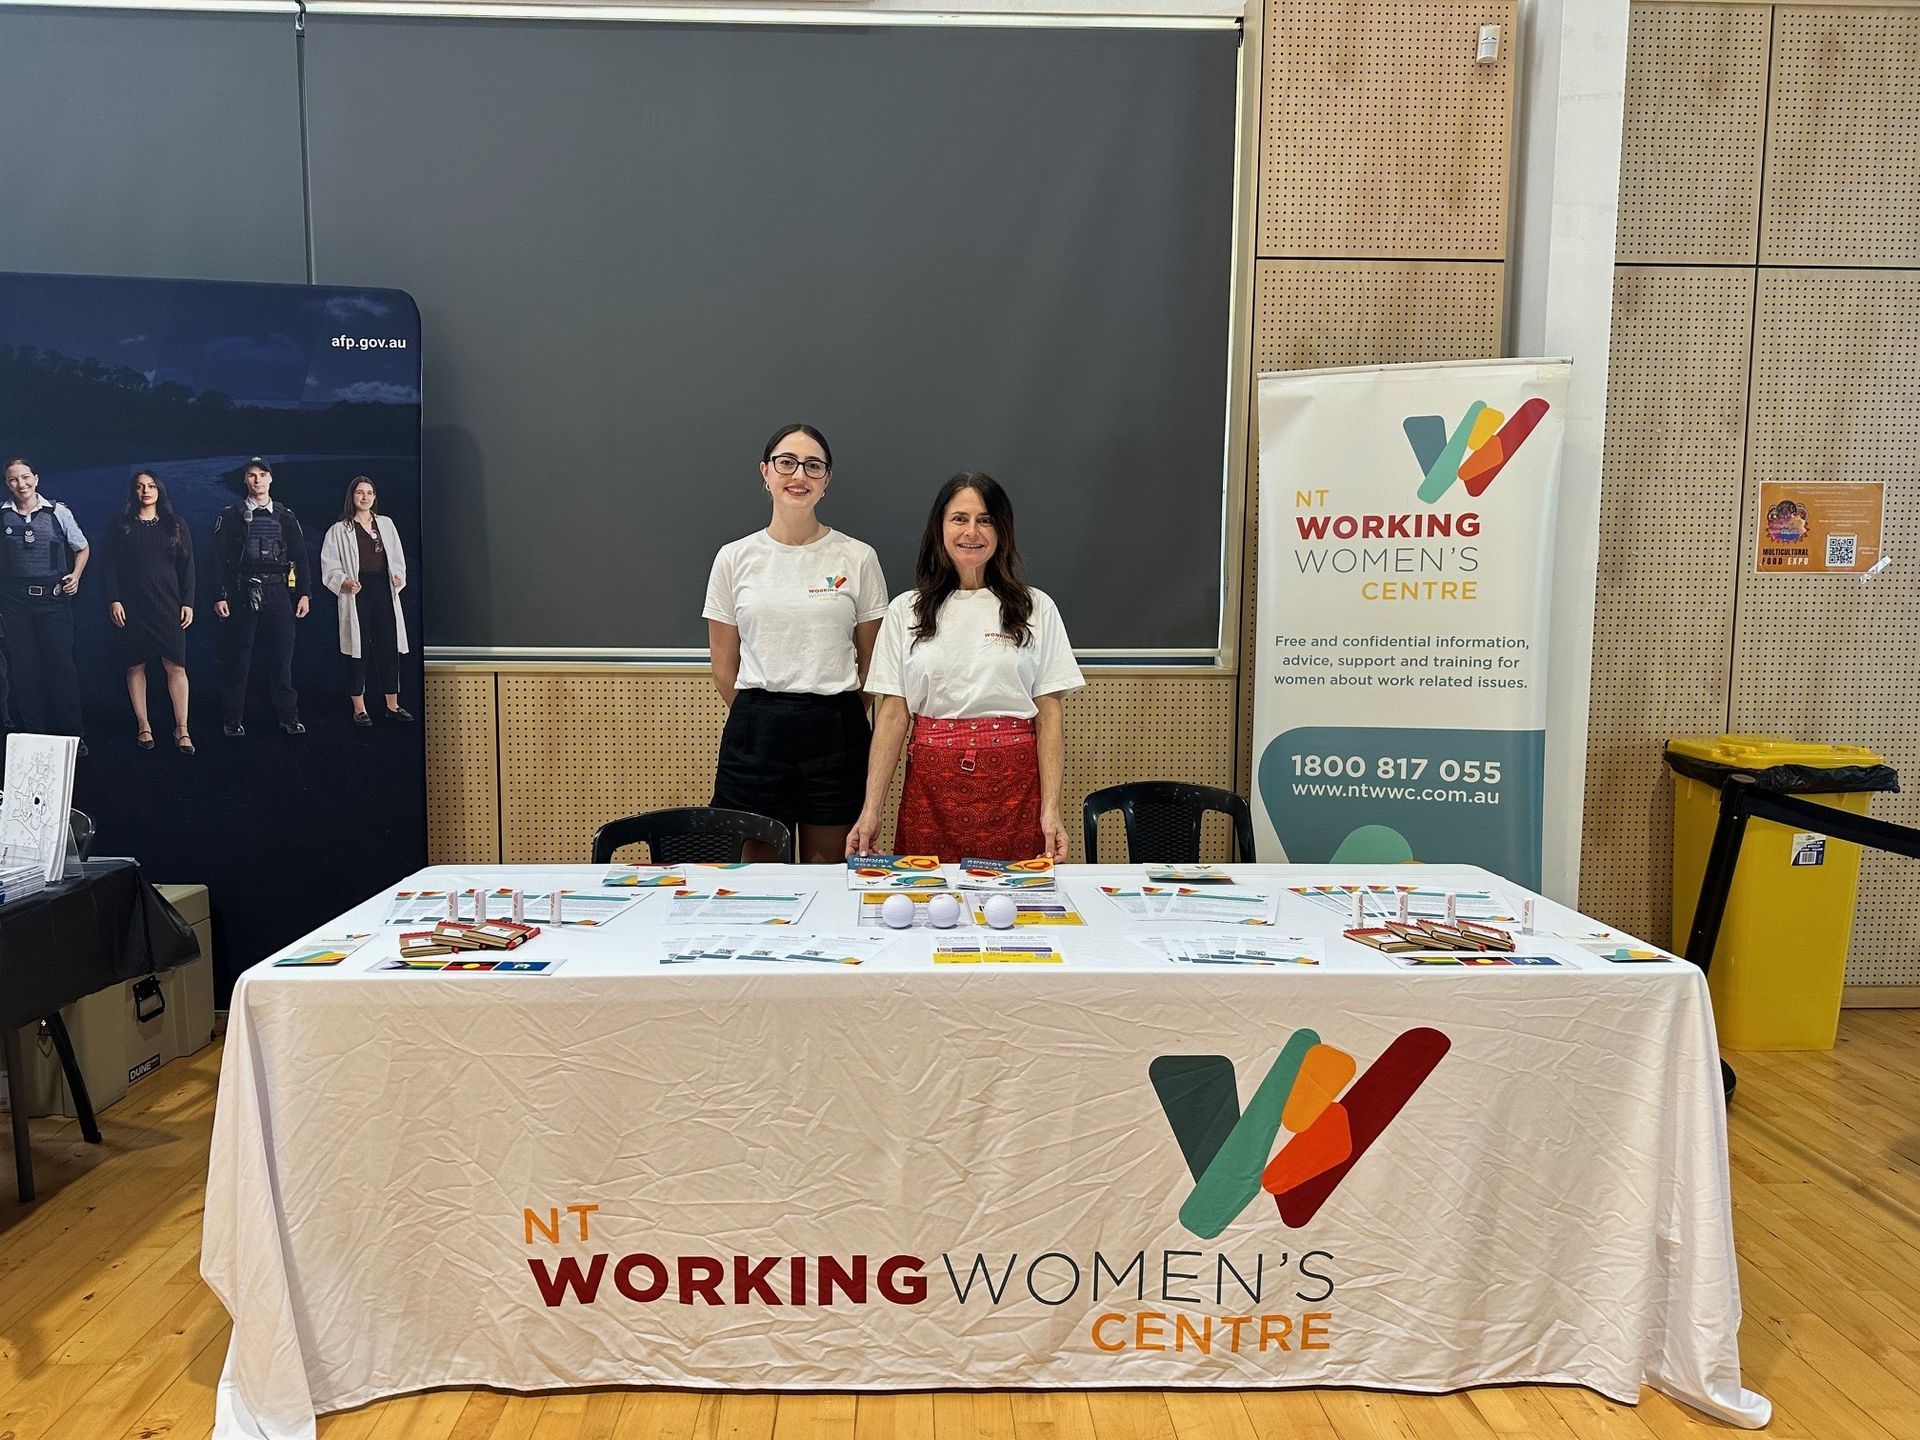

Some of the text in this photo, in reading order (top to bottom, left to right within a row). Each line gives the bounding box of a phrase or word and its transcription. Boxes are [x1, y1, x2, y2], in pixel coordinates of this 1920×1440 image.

[331, 334, 407, 351] afp.gov.au
[1295, 489, 1329, 508] NT
[1296, 512, 1481, 540] WORKING
[1294, 546, 1479, 574] WOMEN'S
[1761, 557, 1809, 566] FOOD EXPO
[1762, 548, 1809, 556] MULTICULTURAL
[1361, 581, 1478, 601] CENTRE
[1275, 635, 1530, 650] Free and confidential information,
[1282, 654, 1520, 671] advice, support and training for
[1273, 673, 1528, 689] women about work related issues.
[1291, 754, 1501, 784] 1800 817 055
[1292, 783, 1499, 805] www.ntwwc.com.au
[130, 1061, 152, 1080] DUNE
[523, 1204, 599, 1244] NT
[527, 1250, 1335, 1308] WORKING WOMEN'S
[1091, 1311, 1332, 1357] CENTRE
